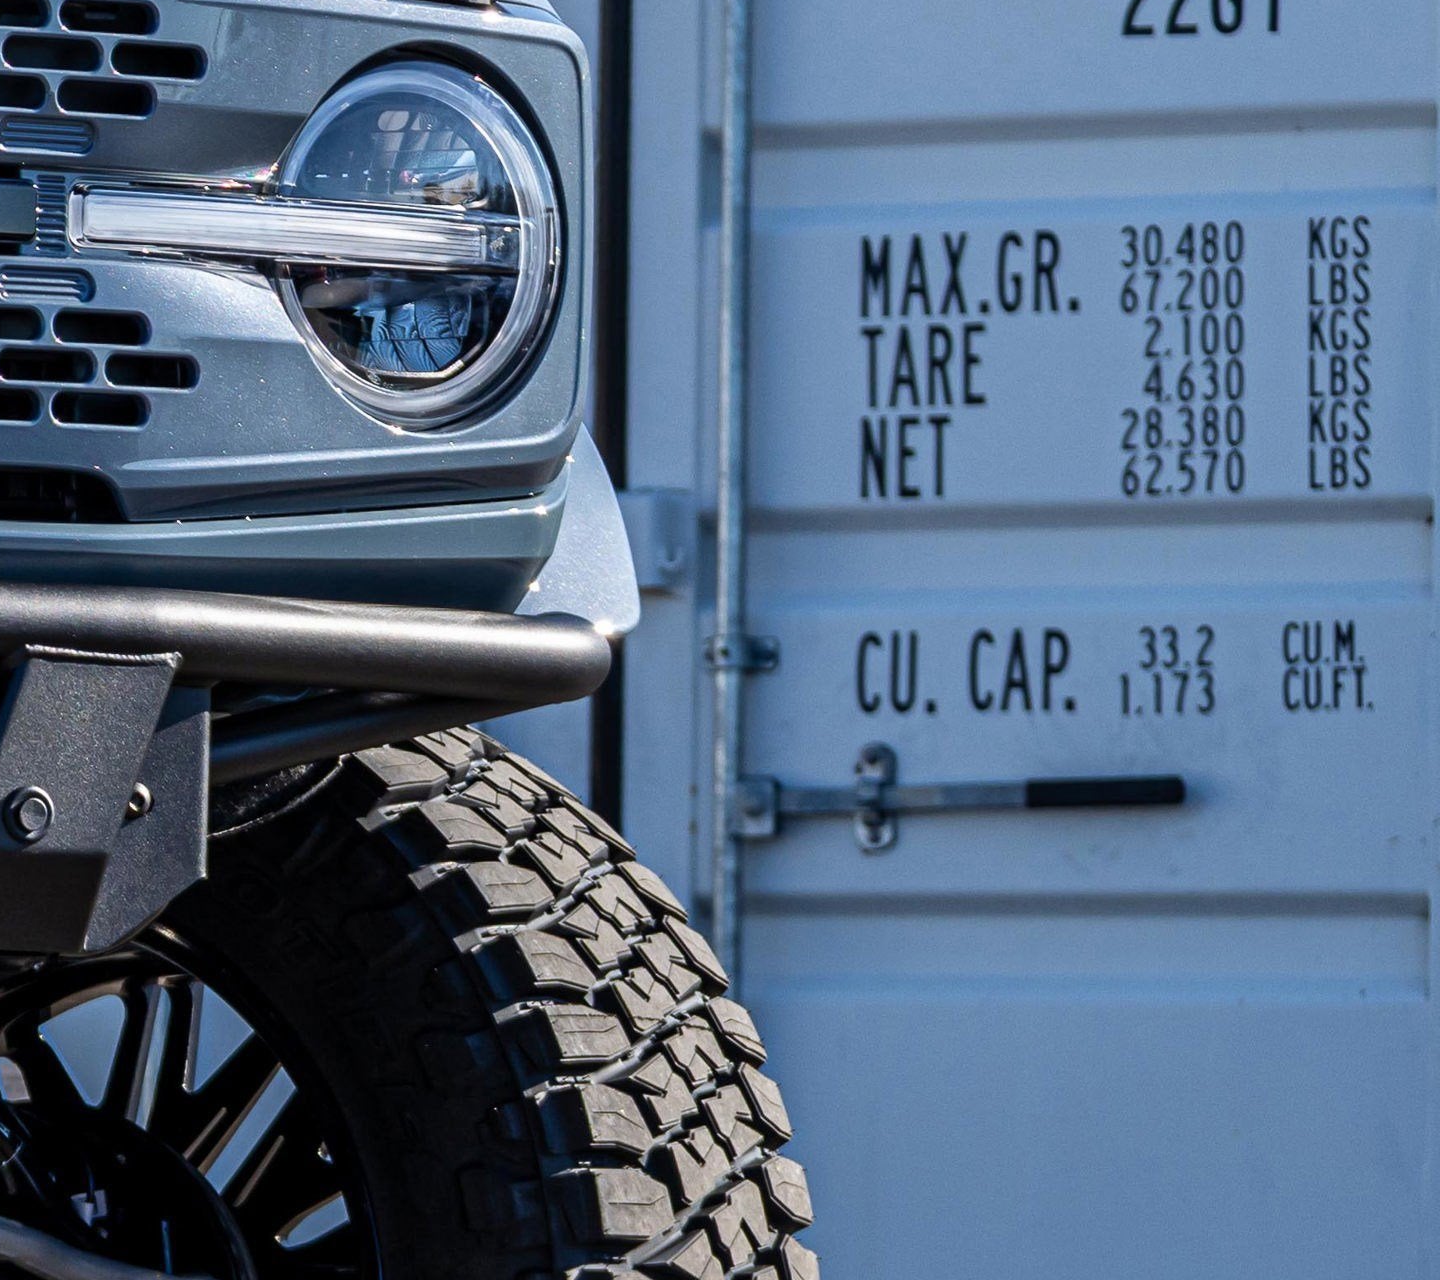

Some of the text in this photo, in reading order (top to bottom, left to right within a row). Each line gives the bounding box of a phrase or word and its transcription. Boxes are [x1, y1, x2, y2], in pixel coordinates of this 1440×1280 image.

[1120, 215, 1371, 268] 30.480 KGS
[860, 230, 1080, 318] MAX.GR.
[1120, 261, 1371, 314] 67.200 LBS
[1143, 307, 1371, 359] 2.100 KGS
[861, 323, 987, 408] TARE
[1143, 353, 1371, 402] 4.630 LBS
[1120, 399, 1371, 451] 28.380 KGS
[860, 415, 952, 500] NET
[1120, 444, 1371, 496] 62.570 LBS
[1139, 620, 1367, 670] 33.2 CU.M.
[856, 628, 1077, 715] CU. CAP.
[1120, 665, 1374, 716] 1.173 CU.FT.
